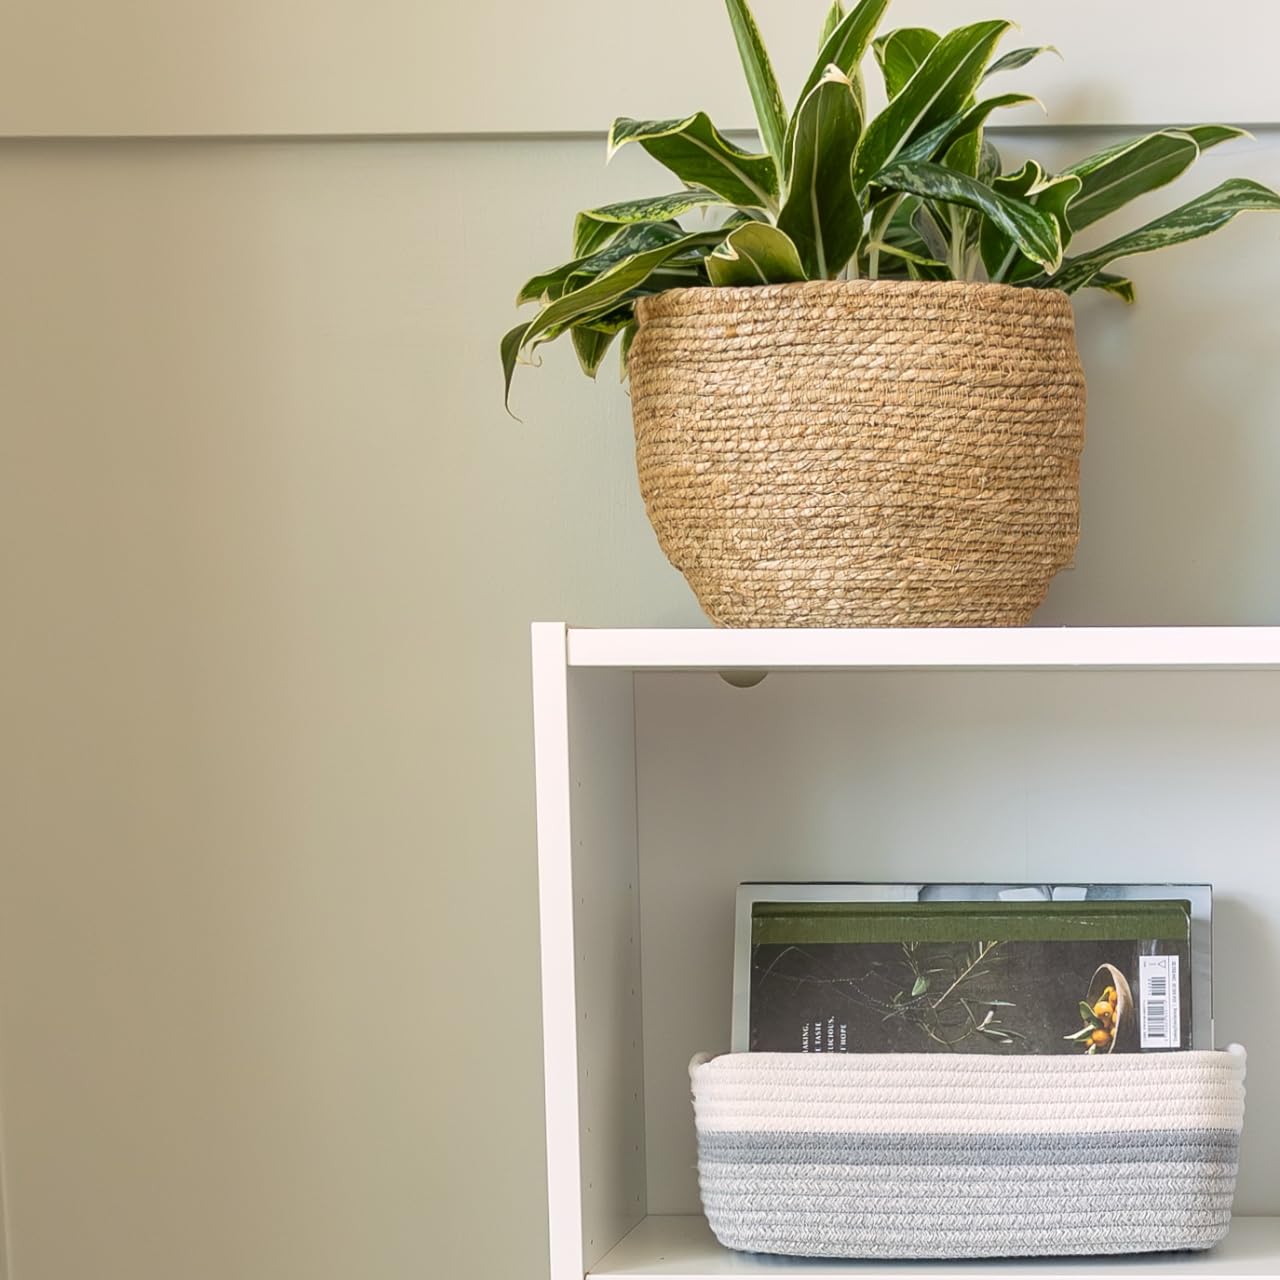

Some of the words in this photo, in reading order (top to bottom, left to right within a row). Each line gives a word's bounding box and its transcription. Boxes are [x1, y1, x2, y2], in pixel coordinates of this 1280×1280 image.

[802, 1022, 810, 1053] AKING,
[814, 1021, 822, 1045] TASTE
[839, 1024, 847, 1046] HOPE
